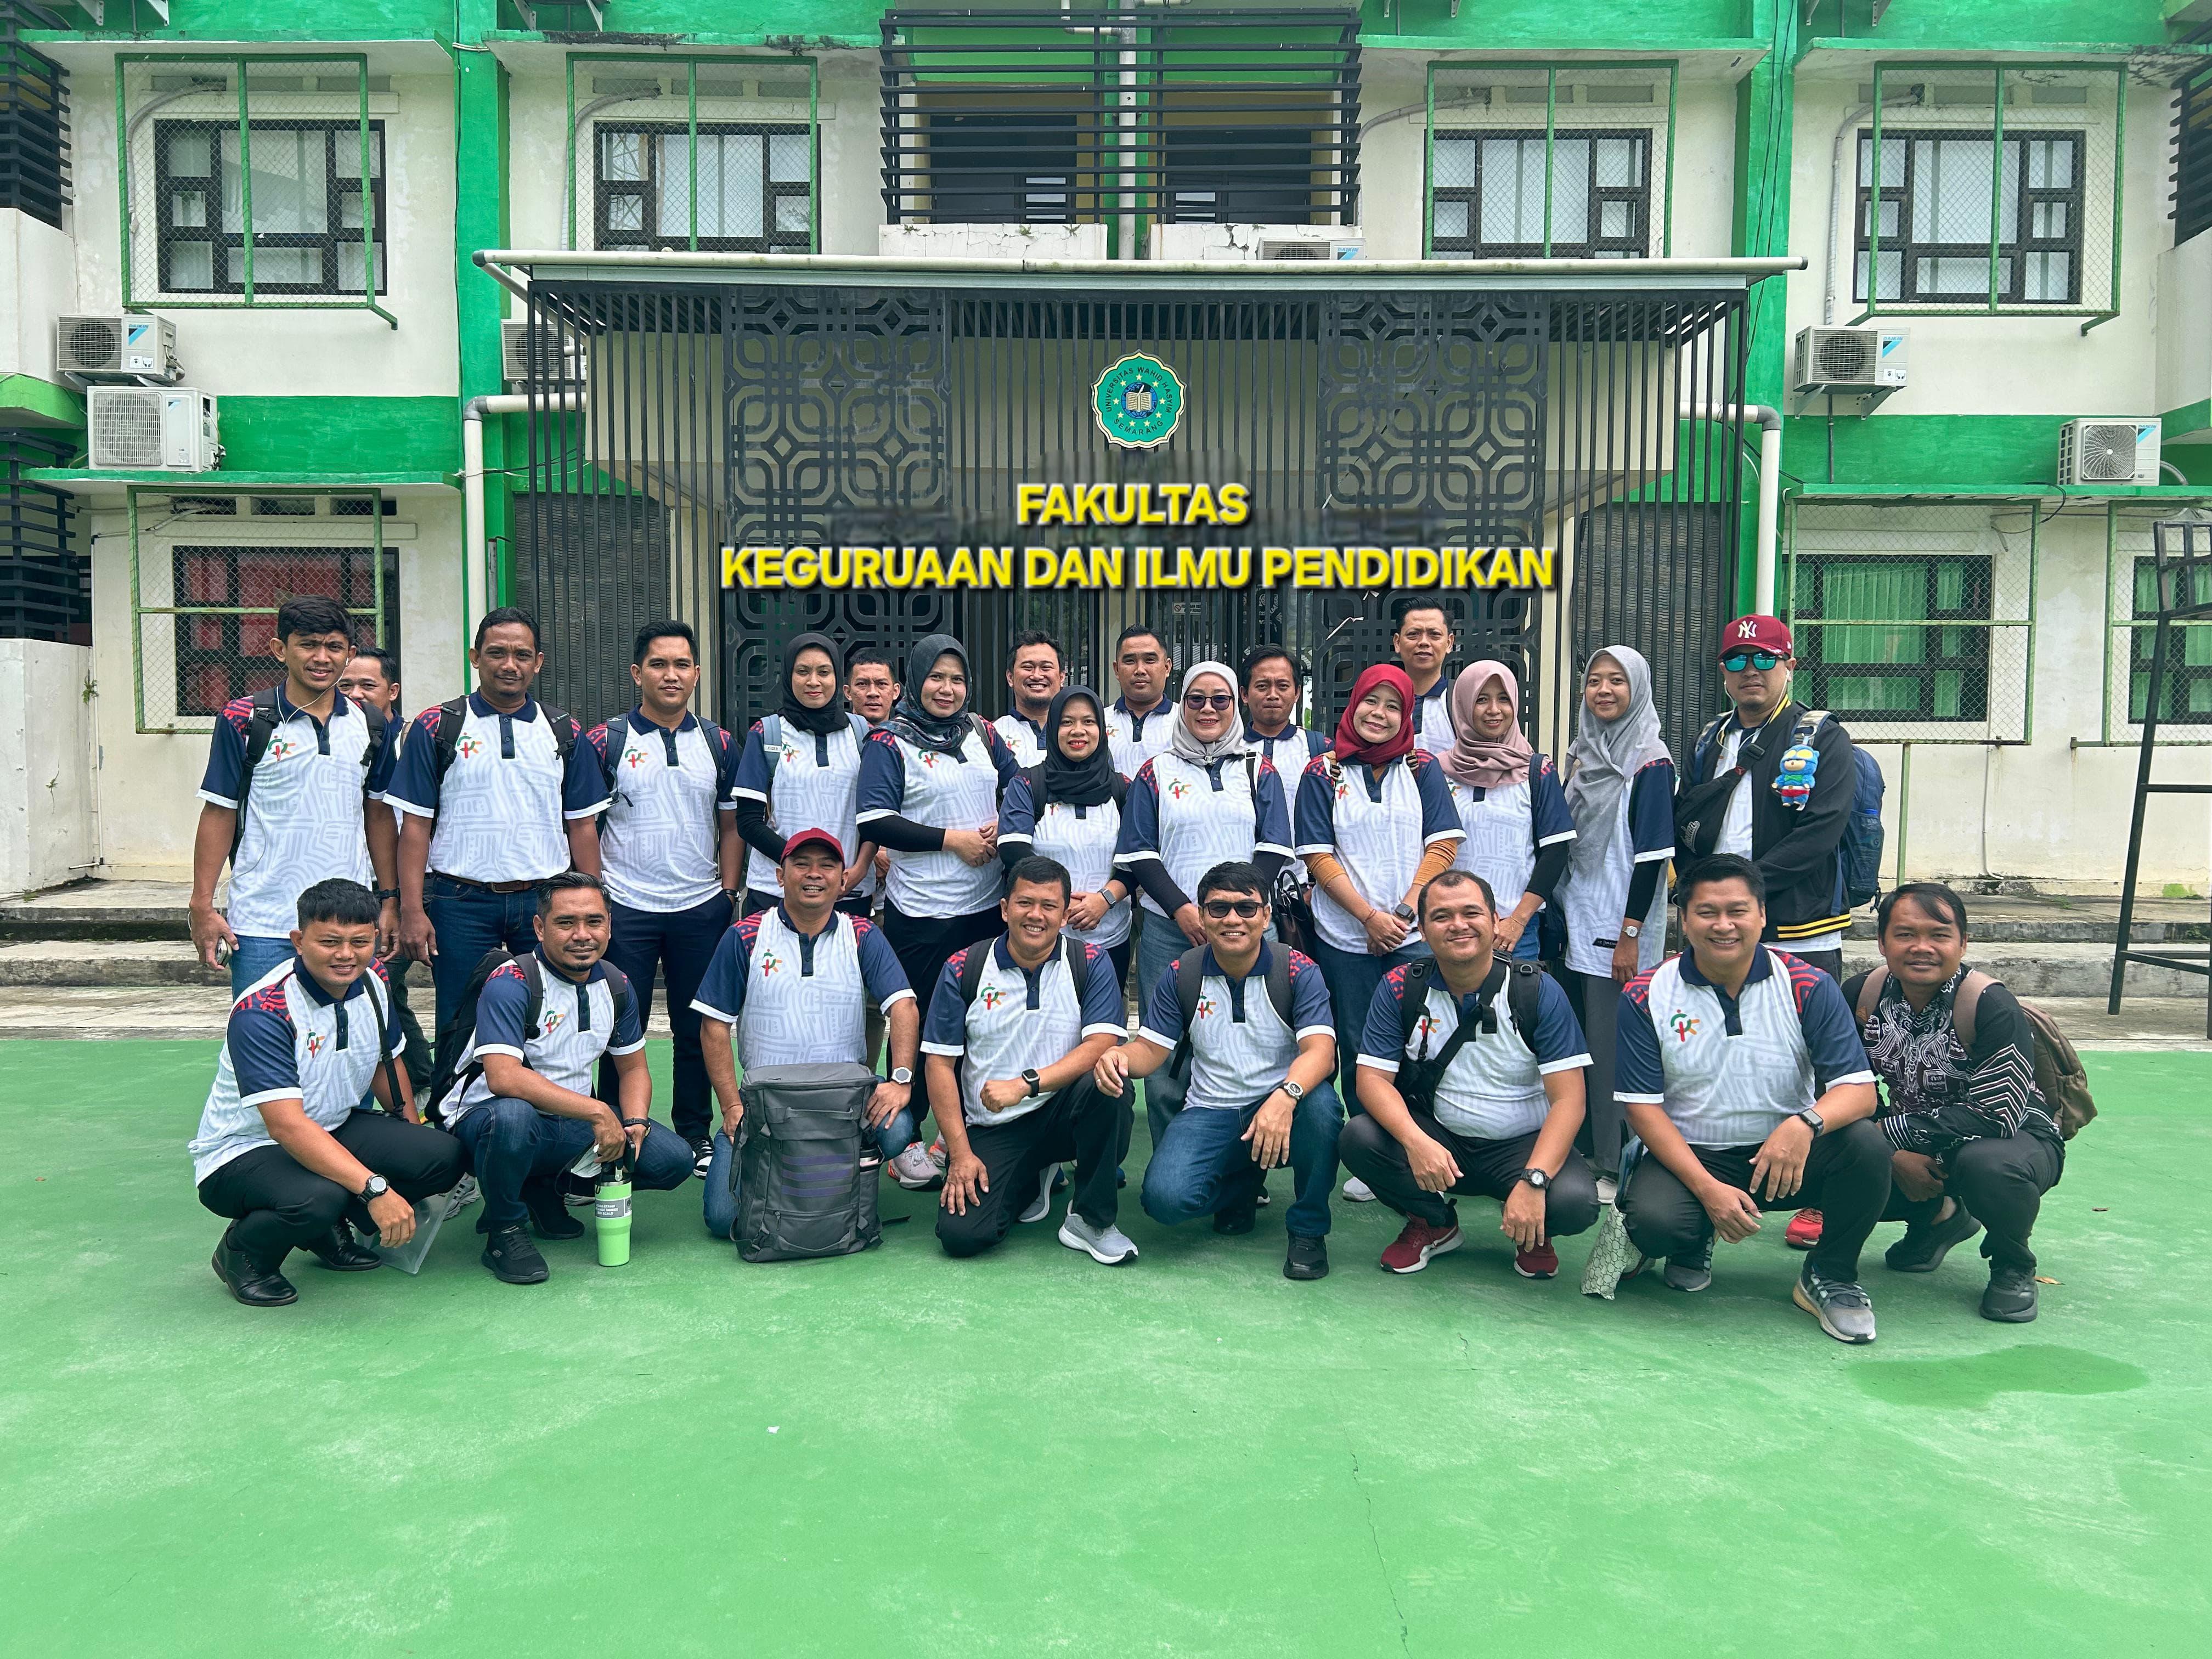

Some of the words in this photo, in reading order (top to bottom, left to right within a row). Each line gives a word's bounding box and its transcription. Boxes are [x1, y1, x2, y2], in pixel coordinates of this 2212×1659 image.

[1105, 368, 1134, 412] UNIVERSITAS
[1137, 366, 1163, 382] WAHID
[1161, 382, 1173, 413] HASYIM
[1114, 419, 1164, 435] SEMARANG
